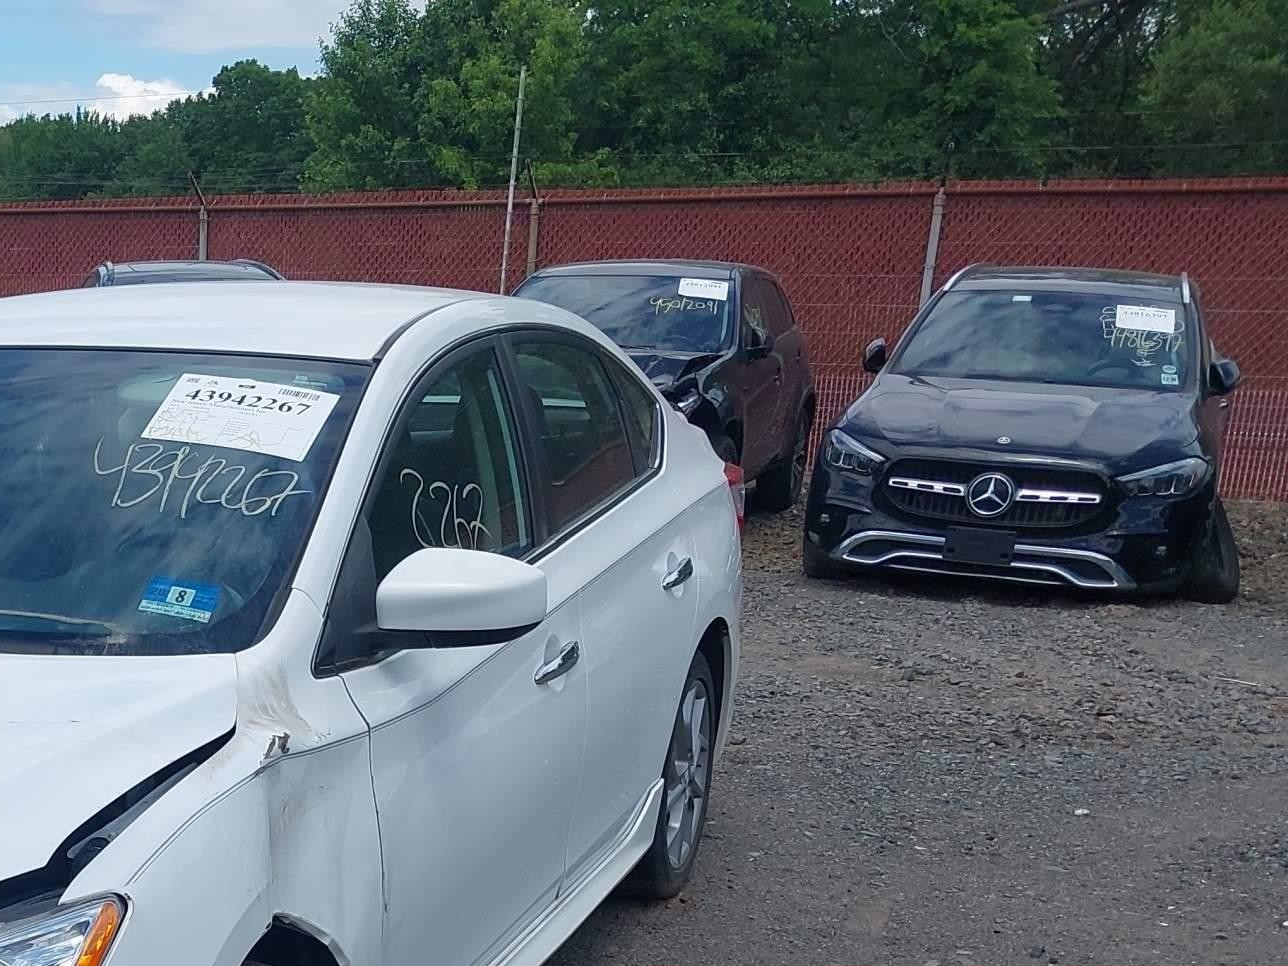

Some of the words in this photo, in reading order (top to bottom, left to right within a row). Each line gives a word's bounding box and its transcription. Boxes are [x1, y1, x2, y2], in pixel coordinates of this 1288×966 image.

[185, 388, 311, 416] 43942267
[94, 436, 312, 519] 43942267
[175, 590, 187, 603] 8
